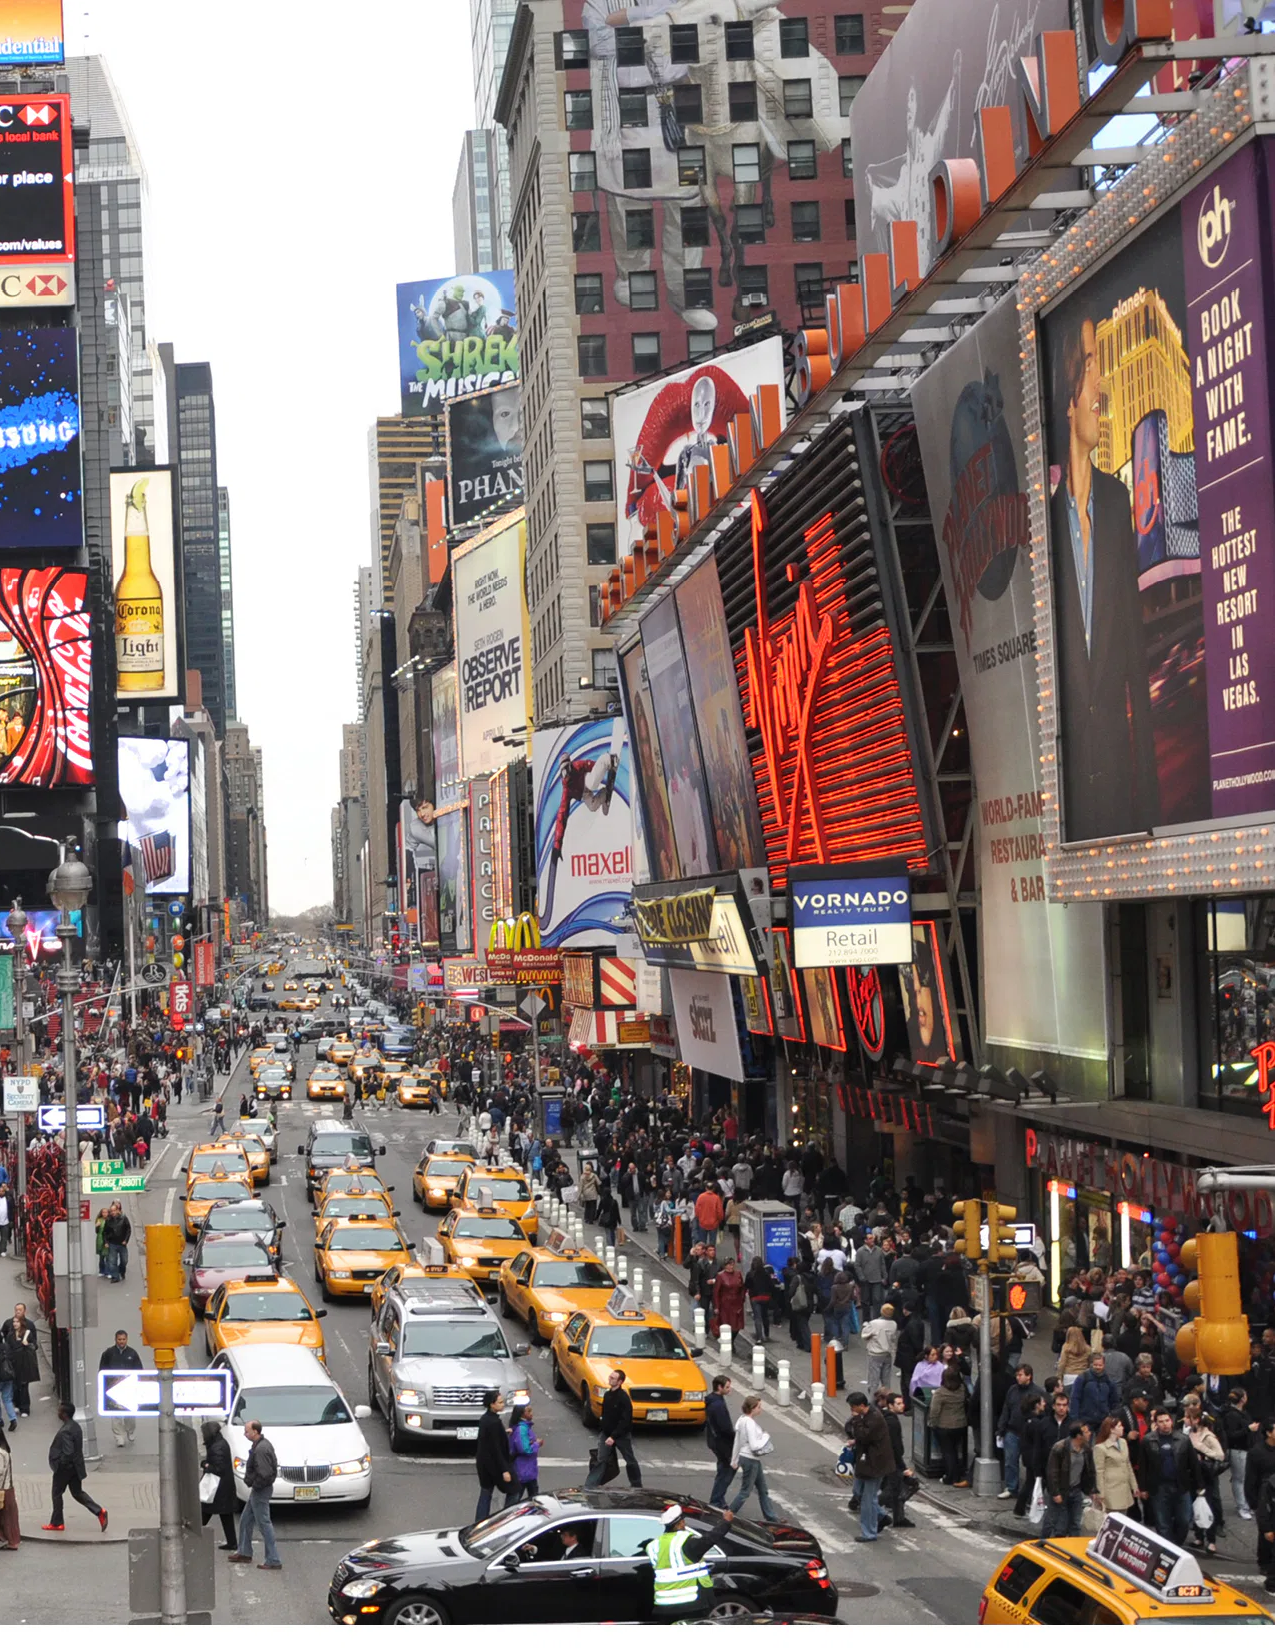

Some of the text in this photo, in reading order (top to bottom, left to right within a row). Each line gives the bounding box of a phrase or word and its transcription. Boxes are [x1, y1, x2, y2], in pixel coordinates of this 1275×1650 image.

[5, 132, 31, 143] local
[32, 131, 59, 142] bank
[13, 171, 53, 187] place
[1112, 286, 1146, 322] planet
[1201, 288, 1242, 344] BOOK
[411, 334, 519, 382] SHREK
[1196, 322, 1253, 388] A NIGHT
[408, 381, 423, 393] THE
[1206, 371, 1244, 422] WITH
[1206, 411, 1252, 463] FAME.
[491, 455, 512, 468] Tonight
[1221, 506, 1241, 536] THE
[1211, 530, 1257, 570] HOTTEST
[476, 576, 507, 601] WORLD NEEDS
[1223, 564, 1247, 593] NEW
[117, 603, 162, 618] Corona
[1217, 589, 1258, 626] RESORT
[121, 638, 159, 657] Light
[1232, 624, 1244, 650] IN
[462, 636, 521, 686] OBSERVE
[973, 630, 1037, 674] TIMES SQUARE
[1229, 652, 1249, 680] LAS
[467, 665, 521, 712] REPORT
[1222, 689, 1260, 712] VEGAS.
[478, 793, 493, 921] PALACE
[571, 846, 633, 877] maxell
[795, 890, 908, 911] VORNADO
[1010, 876, 1045, 903] & BAR
[814, 905, 891, 916] REALTY TRUST
[826, 929, 878, 947] Retail
[514, 953, 562, 961] McDonald's
[174, 984, 188, 1013] tkts
[92, 1163, 100, 1175] W
[101, 1163, 112, 1174] 45
[92, 1179, 116, 1188] GEORGE
